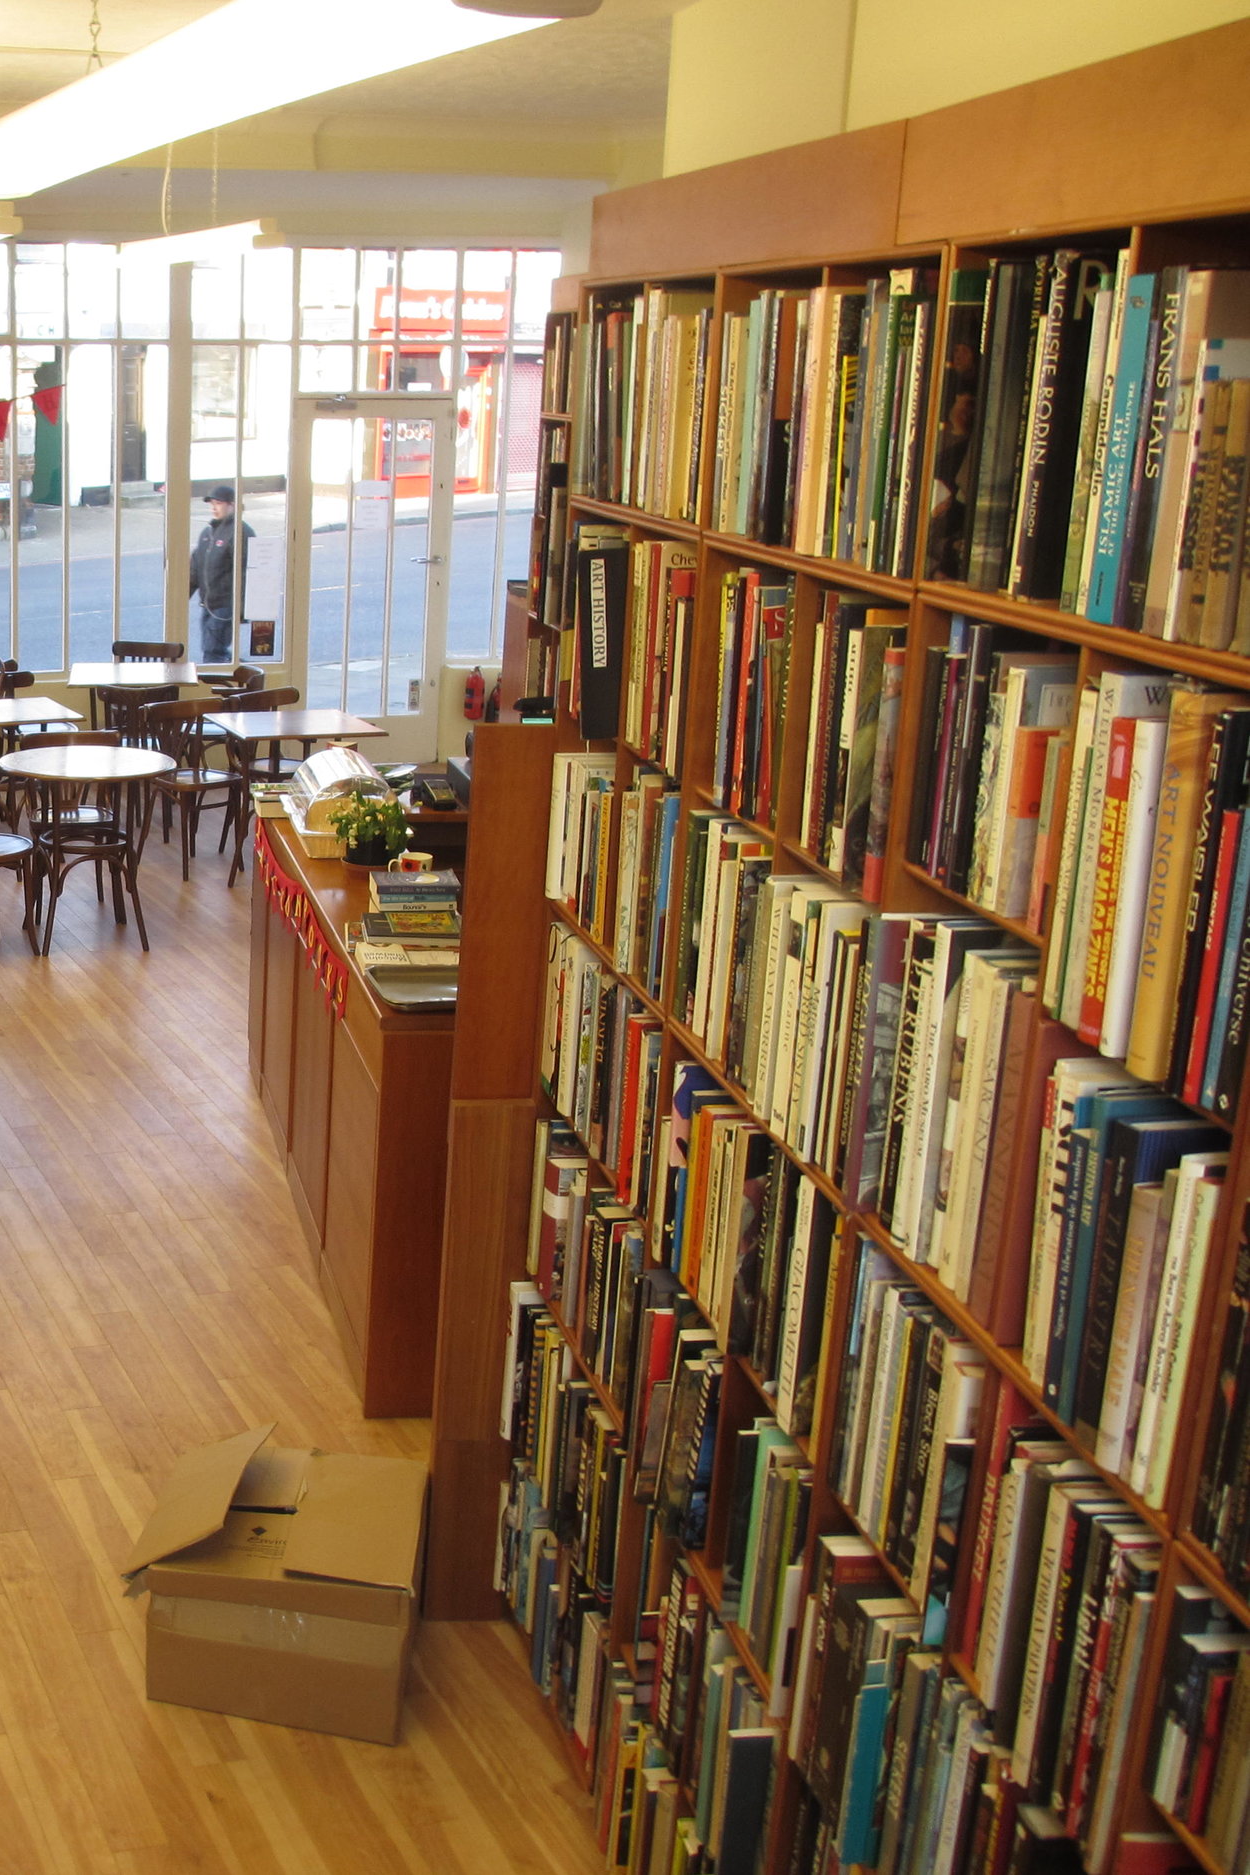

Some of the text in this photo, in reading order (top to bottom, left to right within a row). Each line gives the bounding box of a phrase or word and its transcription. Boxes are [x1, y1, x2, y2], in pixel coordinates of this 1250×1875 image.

[716, 385, 728, 460] SICKERT
[1026, 266, 1068, 538] AUGUSTE RODIN PHAIDON
[1122, 380, 1136, 435] LOUVRE
[1143, 291, 1181, 480] FRANS HALS
[1090, 374, 1115, 497] Campidoglio
[1097, 413, 1124, 555] ISLAMIC ART
[591, 562, 608, 667] ART HISTORY
[830, 624, 840, 648] THE
[827, 651, 838, 676] ART
[819, 700, 835, 790] ROCKEFELLER
[1085, 688, 1115, 864] WILLIAM MORRIS
[1208, 723, 1222, 781] LEE
[599, 821, 607, 851] STORY
[816, 793, 828, 839] CENTER
[1185, 789, 1215, 932] WAISLER
[677, 855, 692, 969] WINSLOW HOMER
[1082, 796, 1119, 997] MEN'S MAGAZINES
[1142, 763, 1182, 980] ART NOUVEAU
[1205, 890, 1218, 949] MONTAGE
[758, 908, 783, 1083] WILLIAM MORRIS
[782, 979, 797, 1052] Cézanne
[792, 957, 814, 1105] ALFRED SISLEY
[807, 987, 821, 1047] Matisse
[1227, 941, 1250, 1045] Universe
[840, 1089, 850, 1146] CIUDADES
[856, 965, 865, 1010] EUROPA
[892, 1009, 918, 1125] RUBENS
[924, 1052, 936, 1095] CAIRO
[916, 1099, 930, 1157] MUSEUM
[974, 1058, 999, 1168] SARGENT
[706, 1196, 718, 1254] SCHWITTERS
[1080, 1148, 1100, 1227] BRITISH ART
[780, 1246, 806, 1397] GIACOMETTI
[825, 1262, 840, 1319] Manet
[1151, 1345, 1168, 1394] Beardsley
[917, 1386, 939, 1477] Black Star
[658, 1573, 684, 1729] ADVERTISING TODAY
[1021, 1545, 1058, 1720] VICTORIAN PAINTERS
[887, 1737, 908, 1822] SICKERT
